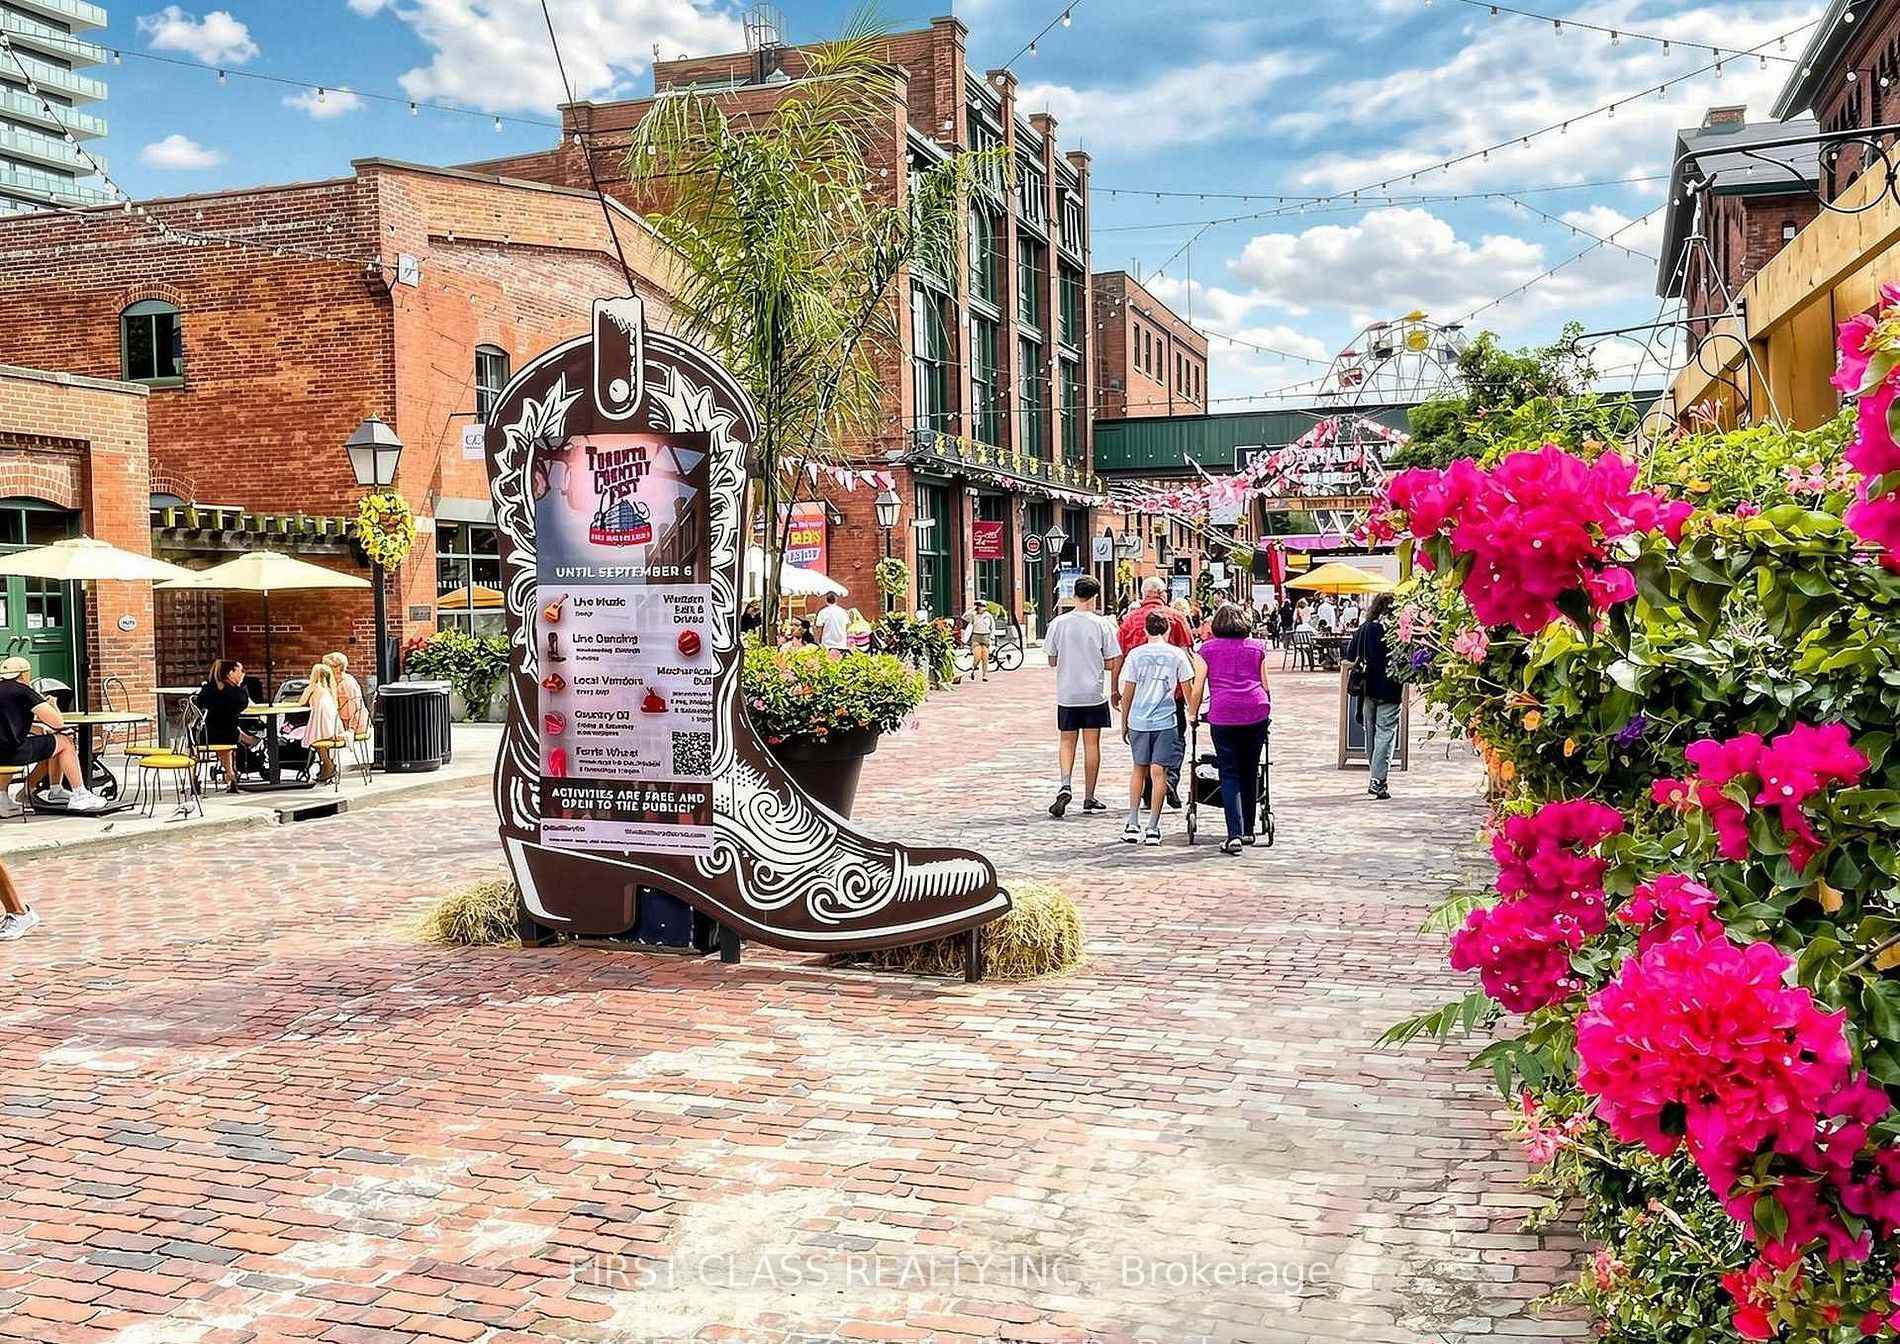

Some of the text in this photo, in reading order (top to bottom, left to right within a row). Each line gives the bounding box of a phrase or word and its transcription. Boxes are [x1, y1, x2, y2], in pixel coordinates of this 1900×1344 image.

[594, 461, 651, 495] COUNTRY
[556, 565, 692, 578] UNTIL SEPTEMBER 6
[573, 676, 599, 685] Local
[551, 787, 706, 804] ACTIVITIES ARE FREE AND
[561, 799, 594, 809] OPEN
[598, 799, 613, 810] TO
[615, 801, 640, 812] THE
